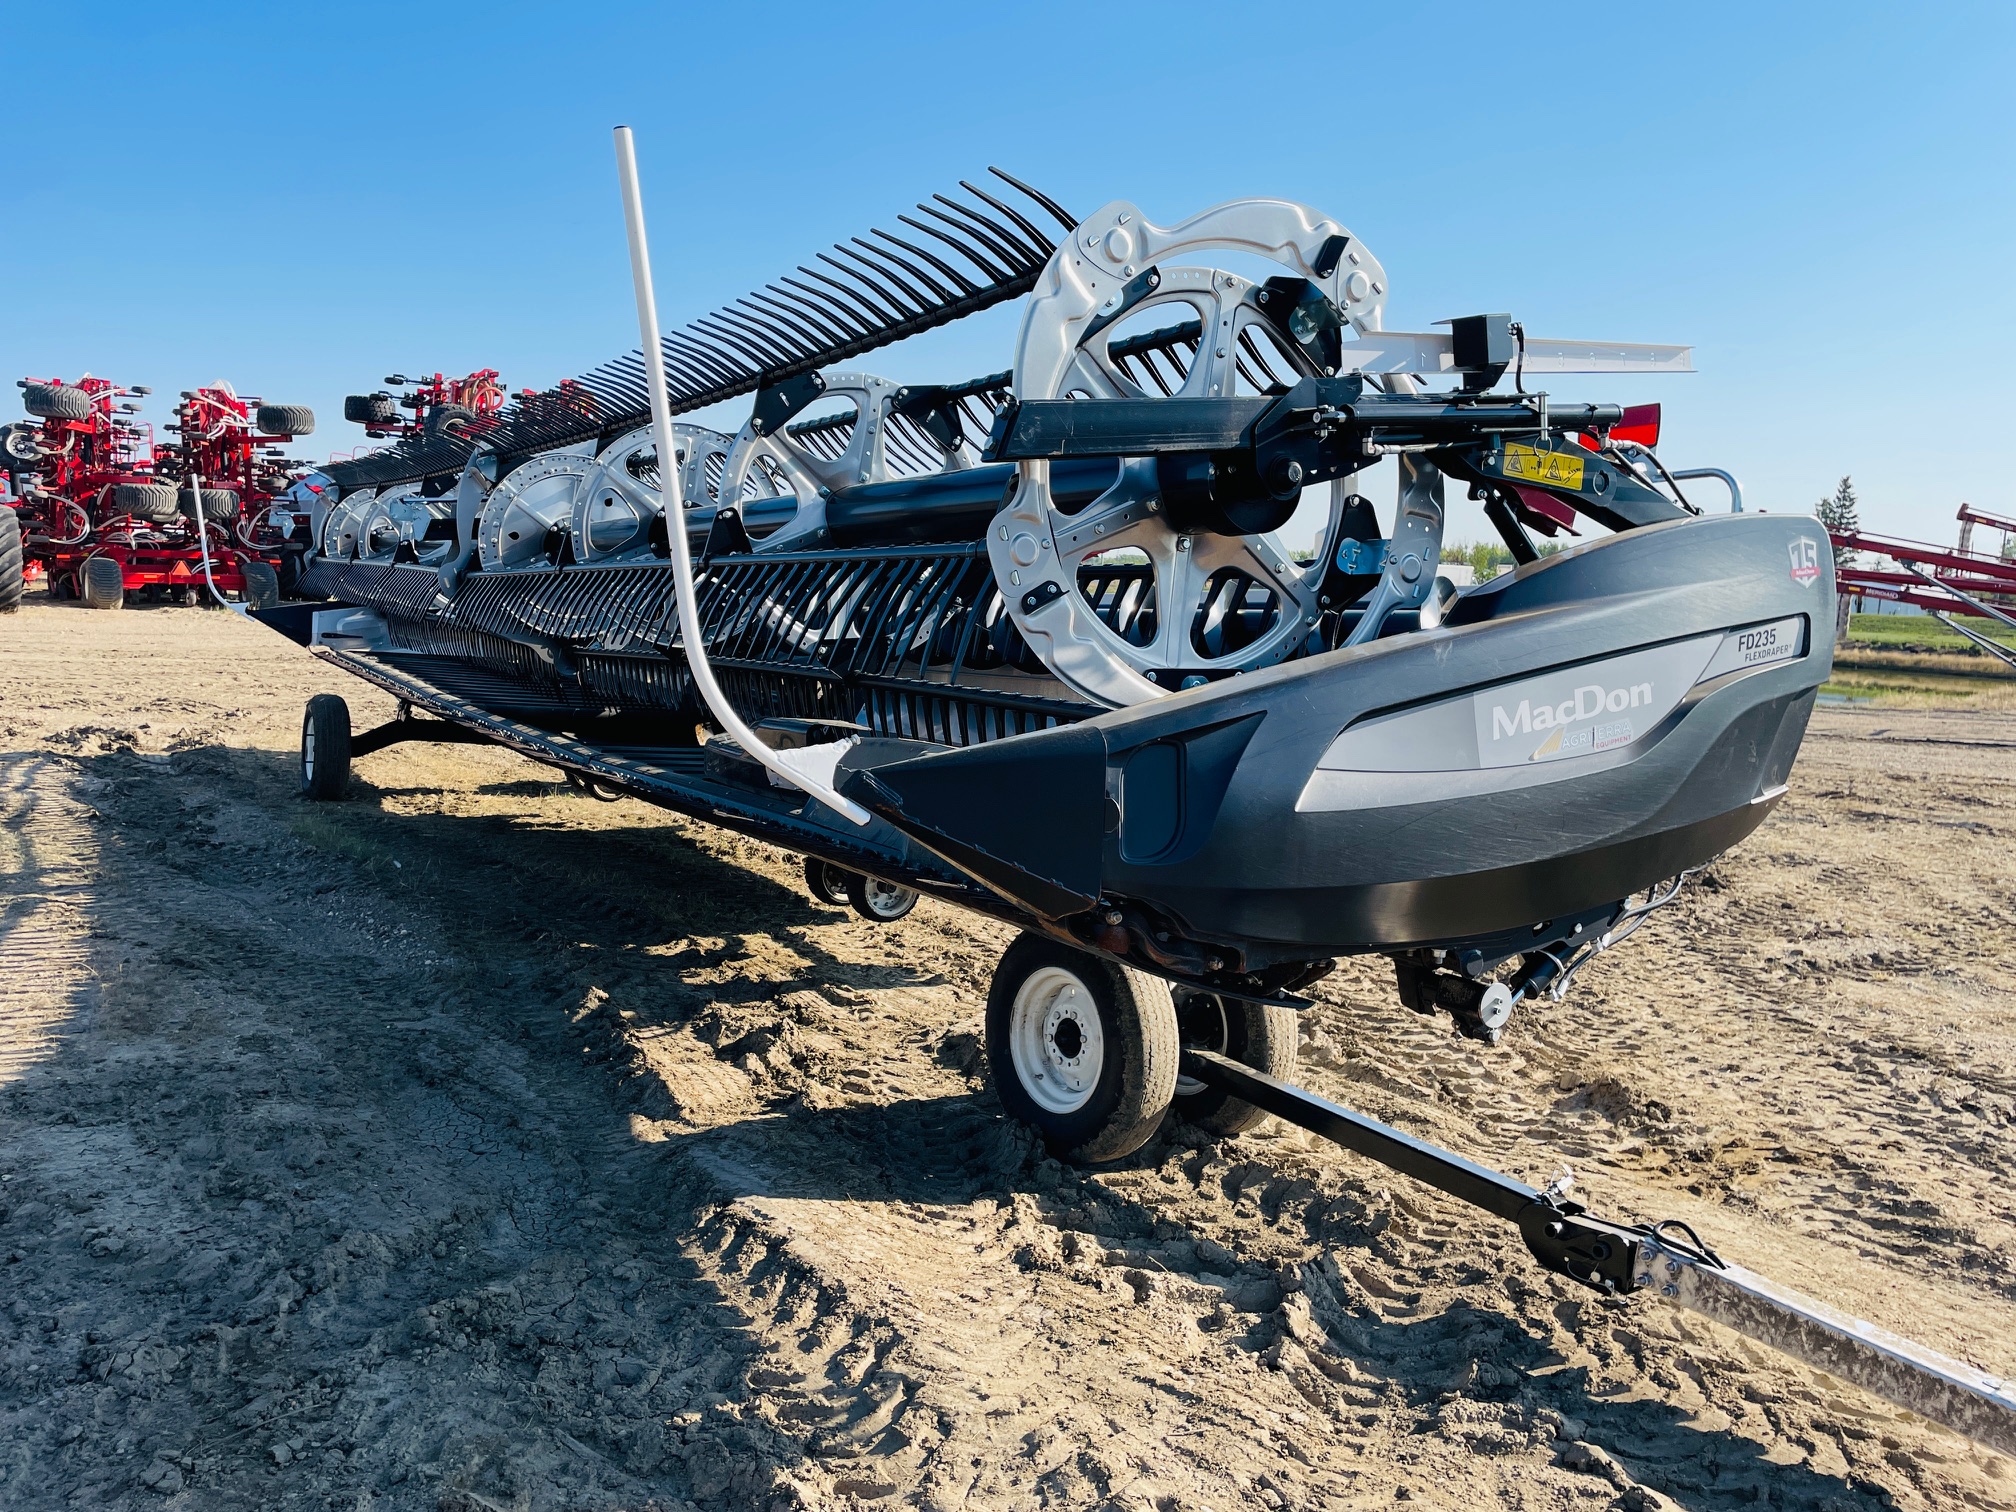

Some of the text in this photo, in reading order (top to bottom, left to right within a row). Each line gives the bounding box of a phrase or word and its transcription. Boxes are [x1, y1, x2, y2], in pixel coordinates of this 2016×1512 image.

[1738, 628, 1777, 652] FD235
[1745, 644, 1789, 662] FLEXDRAPER
[1491, 682, 1652, 741] MacDon
[1596, 735, 1632, 750] EQUIPMENT
